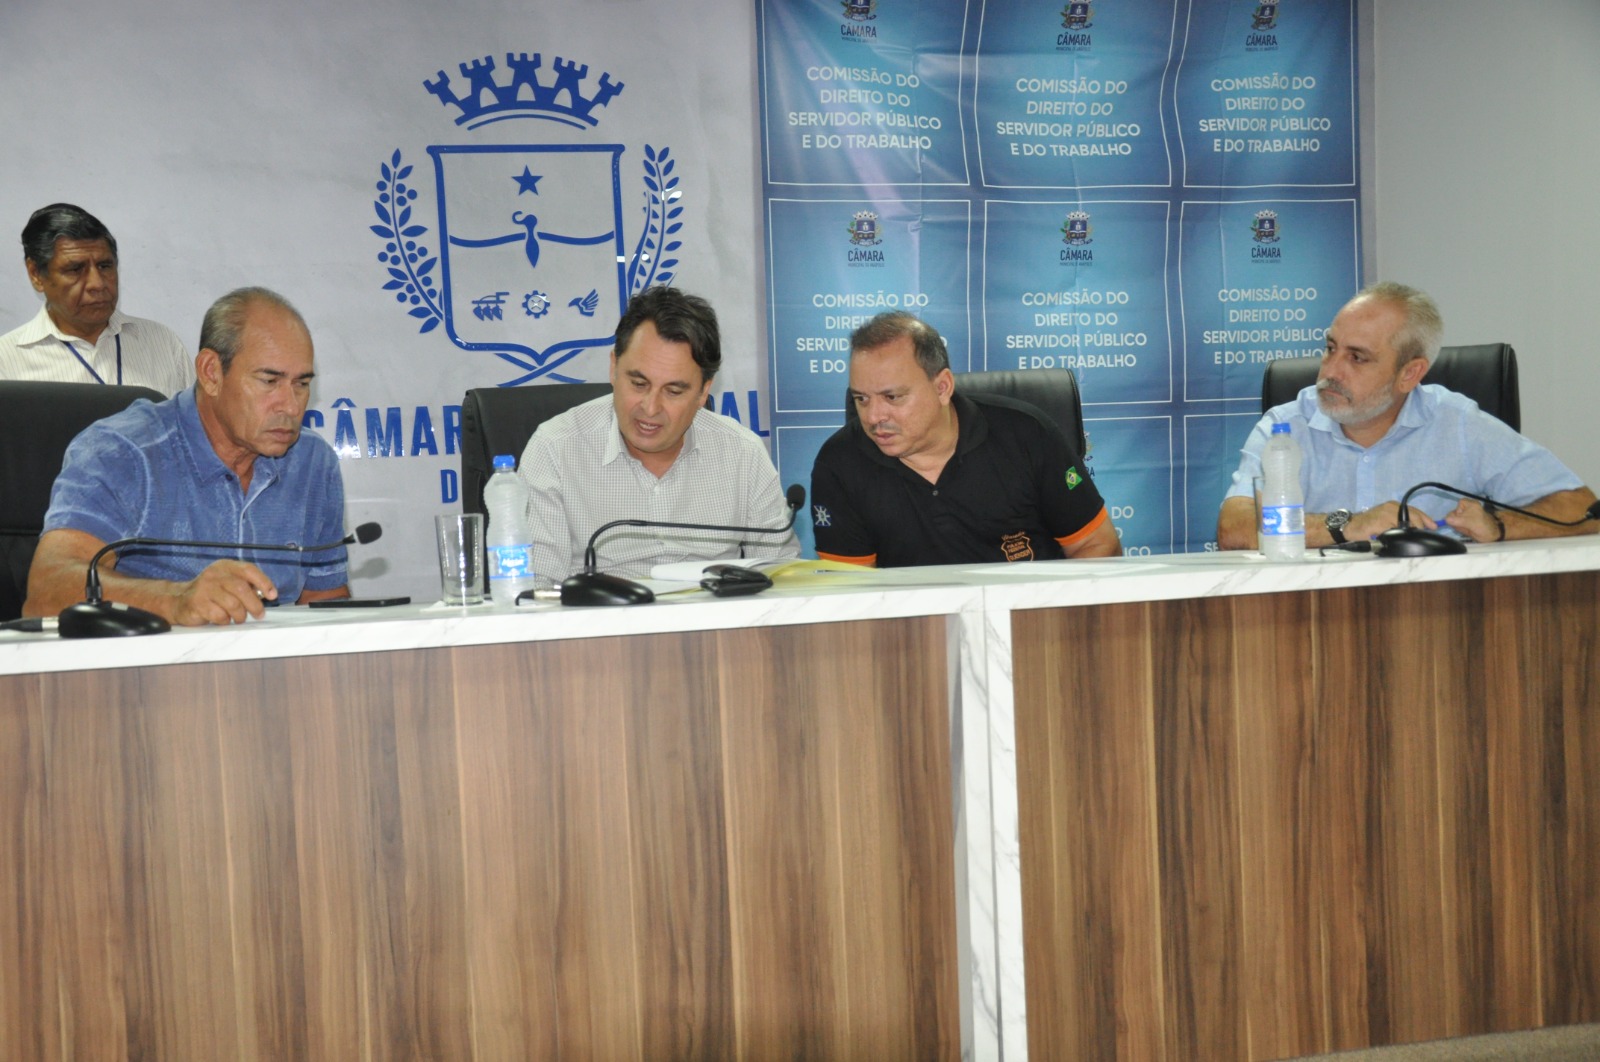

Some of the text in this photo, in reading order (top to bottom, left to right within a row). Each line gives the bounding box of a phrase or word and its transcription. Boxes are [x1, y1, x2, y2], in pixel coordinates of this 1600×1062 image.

[1057, 31, 1092, 46] CÂMARA
[1246, 32, 1278, 46] CÂMARA
[807, 66, 920, 88] COMISSÃO DO
[1211, 73, 1316, 92] COMISSÃO DO
[1016, 77, 1128, 94] COMISSÃO DO
[820, 89, 911, 107] DIREITO DO
[1225, 97, 1305, 111] DIREITO DO
[1026, 101, 1113, 116] DIREITO DO
[788, 109, 942, 130] SERVIDOR PÚBLICO
[1199, 115, 1331, 133] SERVIDOR PÚBLICO
[996, 120, 1141, 138] SERVIDOR PÚBLICO
[802, 135, 932, 149] E DO TRABALHO
[1213, 138, 1320, 153] E DO TRABALHO
[1011, 143, 1132, 157] E DO TRABALHO
[848, 247, 885, 262] CÂMARA
[1060, 247, 1093, 261] CÂMARA
[1251, 245, 1281, 258] CÂMARA
[812, 290, 929, 308] COMISSÃO DO
[1022, 288, 1129, 306] COMISSÃO DO
[1218, 285, 1317, 302] COMISSÃO DO
[1035, 312, 1118, 327] DIREITO DO
[1229, 308, 1307, 323] DIREITO DO
[796, 337, 850, 351] SERVID
[1006, 330, 1147, 349] SERVIDOR PÚBLICO
[1203, 330, 1270, 344] SERVIDOR
[1018, 354, 1137, 370] E DO TRABALHO
[1214, 351, 1222, 365] E
[1224, 351, 1246, 364] DO
[810, 359, 847, 373] E DO
[1111, 505, 1134, 519] DO
